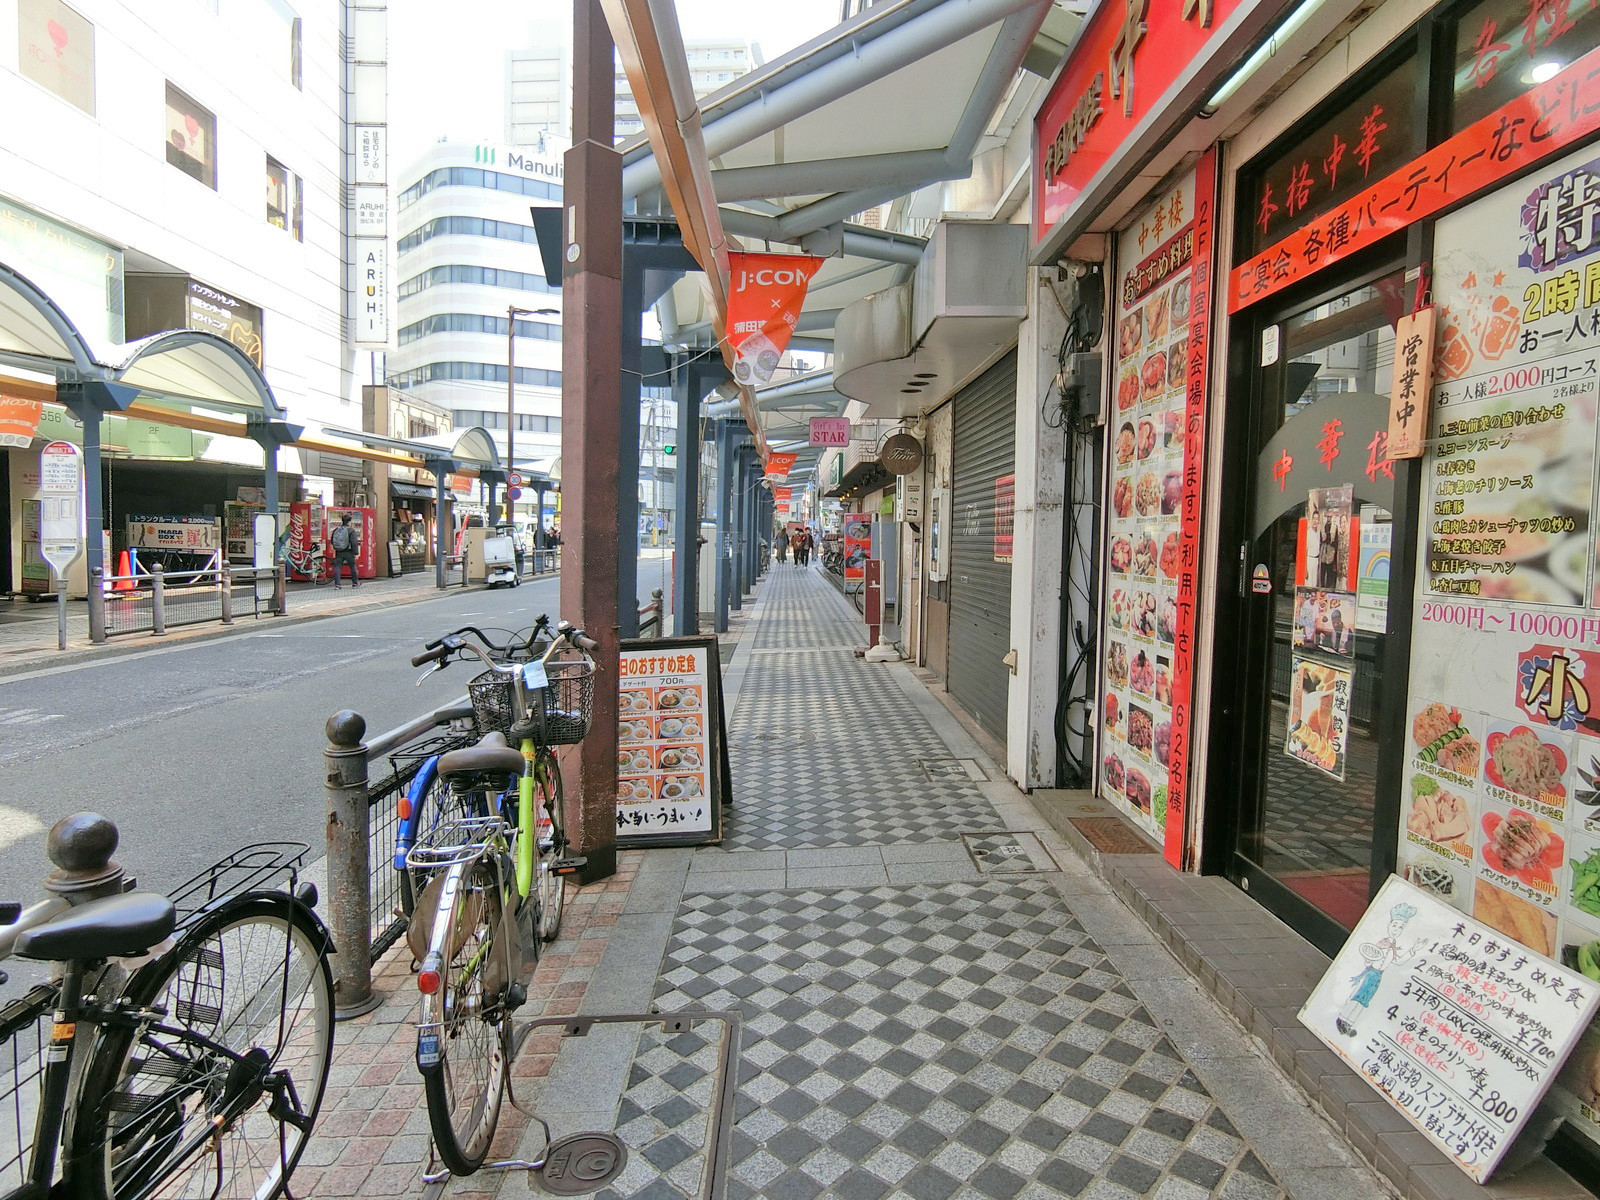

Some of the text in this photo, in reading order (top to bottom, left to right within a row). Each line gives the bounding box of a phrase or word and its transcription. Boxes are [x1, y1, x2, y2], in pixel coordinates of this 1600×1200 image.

[1256, 104, 1388, 235] 本格中華
[366, 252, 376, 330] ARUHI
[1395, 333, 1423, 429] 営業中
[1552, 381, 1595, 400] 2名様より
[149, 426, 160, 435] 2F
[813, 431, 845, 442] STAR
[1436, 459, 1476, 476] 3.春巻き
[1435, 475, 1534, 495] 4.海老のチリソース
[1434, 499, 1465, 515] 5.酢豚
[134, 515, 178, 523] トランクルーム
[1431, 559, 1517, 575] 8.五目チャーハン
[659, 677, 684, 685] 700円
[1450, 922, 1586, 1010] 本日おすすめ定食
